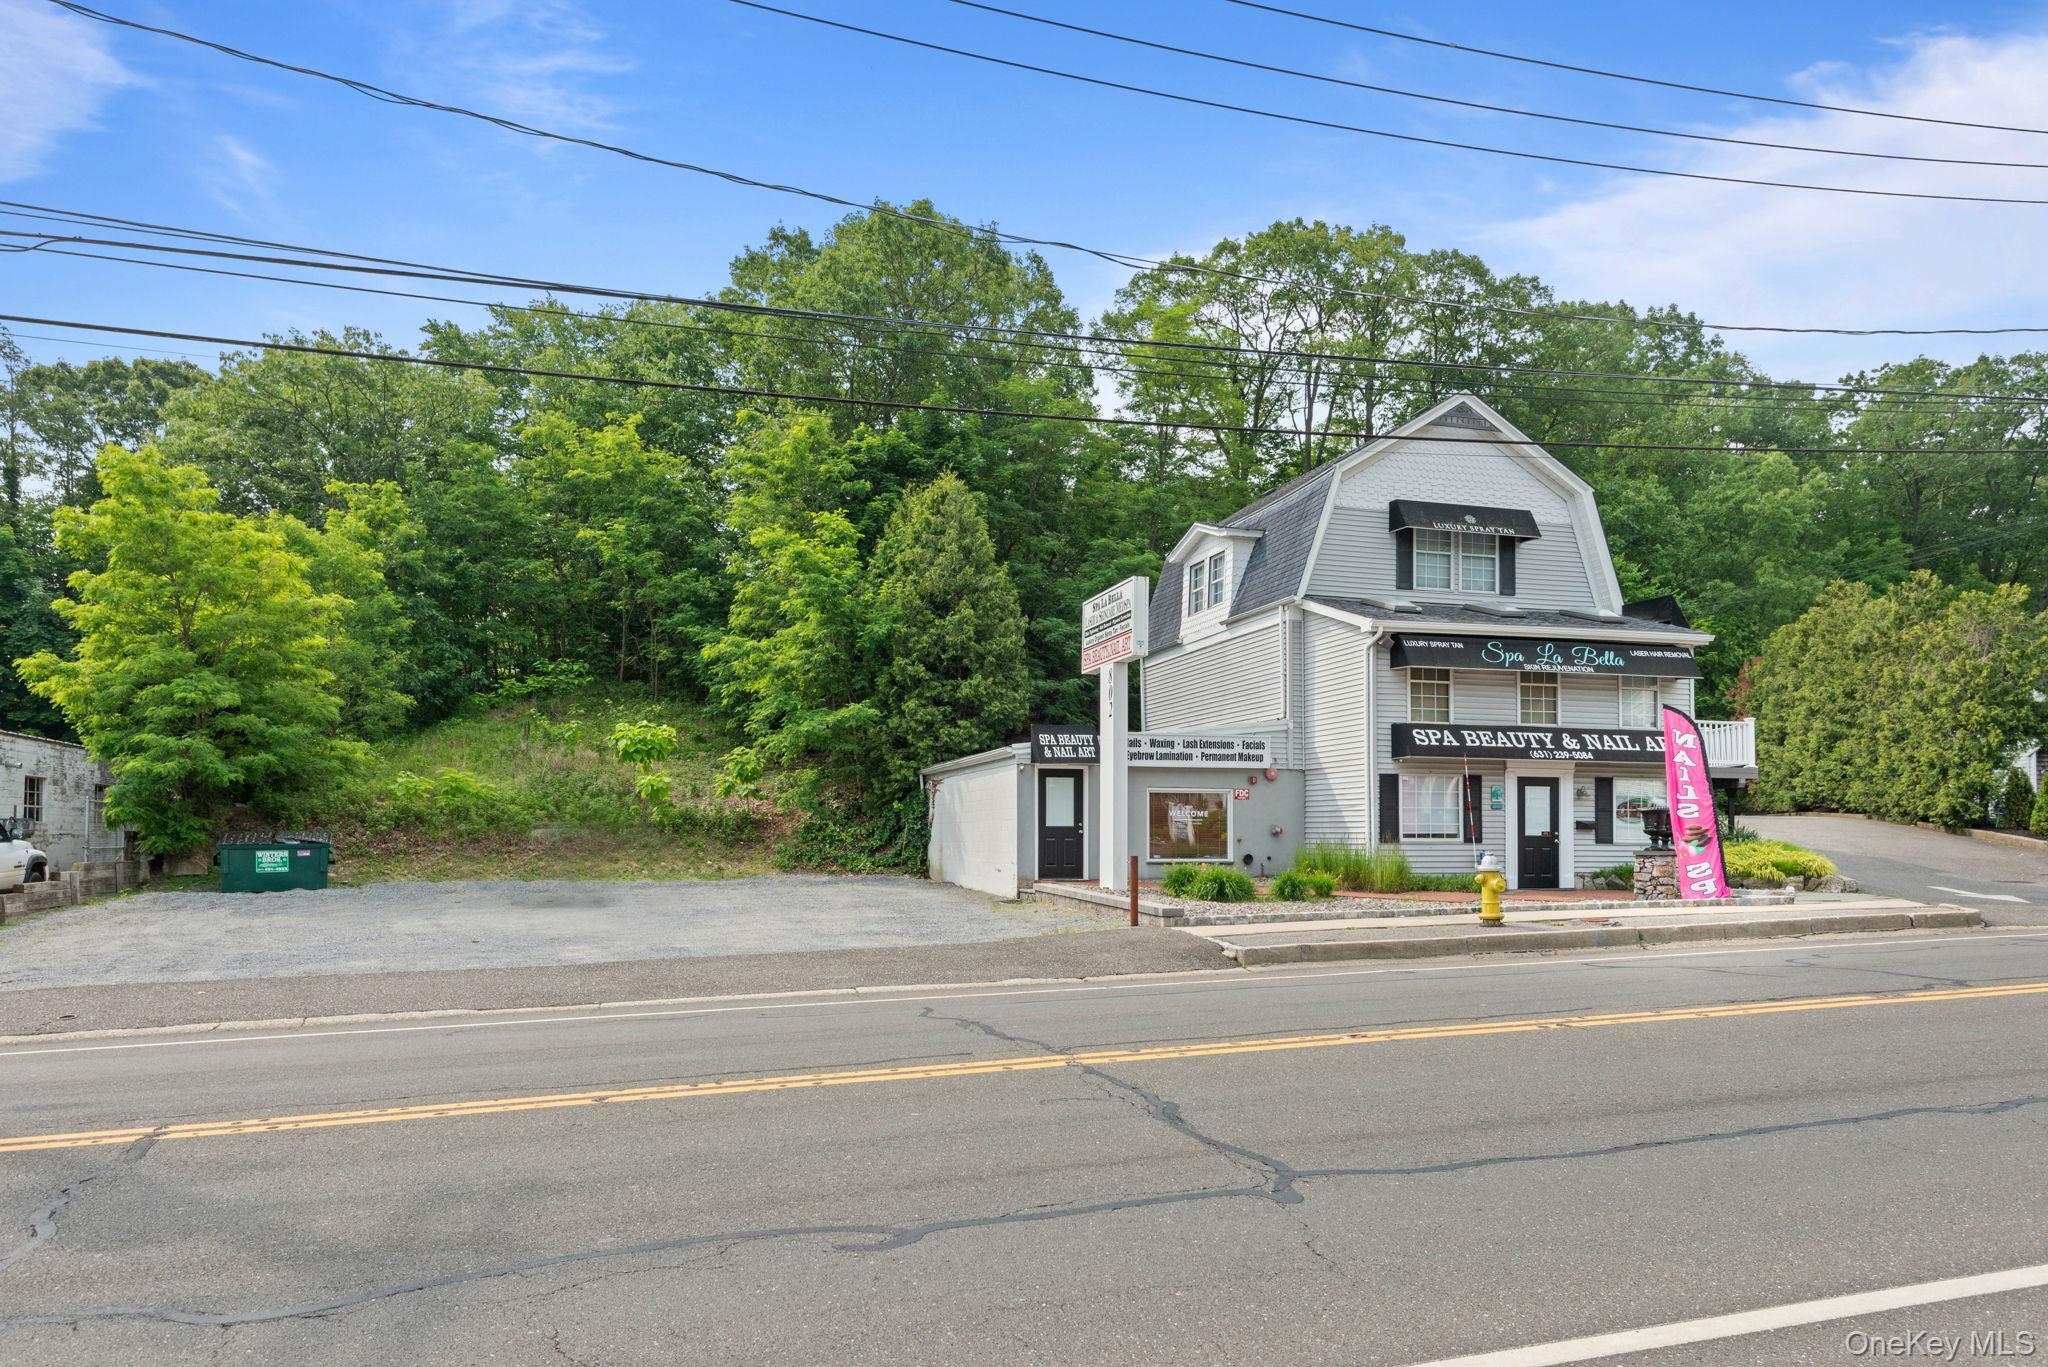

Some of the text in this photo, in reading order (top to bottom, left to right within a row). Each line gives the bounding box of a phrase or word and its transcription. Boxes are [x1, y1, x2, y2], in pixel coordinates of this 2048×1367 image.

[1433, 522, 1515, 535] LUXURY SPRAY TAN
[1403, 640, 1428, 648] LUXURY
[1481, 641, 1626, 668] Spa La Bella
[1663, 651, 1692, 659] REMOVAL
[1523, 663, 1595, 673] SKIN REJUVENATION
[1038, 733, 1094, 746] SPA BEAUTY
[1128, 738, 1266, 750] ails Waxing Lash Extensions Facials
[1412, 728, 1460, 746] SPA
[1460, 730, 1555, 749] BEAUTY
[1562, 733, 1580, 750] &
[1582, 734, 1641, 751] NAIL
[1044, 746, 1096, 758] & NAIL ART
[1155, 750, 1194, 761] Lamination
[1200, 751, 1237, 762] Permanent
[1238, 752, 1264, 763] Makeup
[1529, 750, 1594, 760] (631) 239-5084
[1235, 789, 1249, 797] FDC
[1168, 810, 1209, 818] WELCOME
